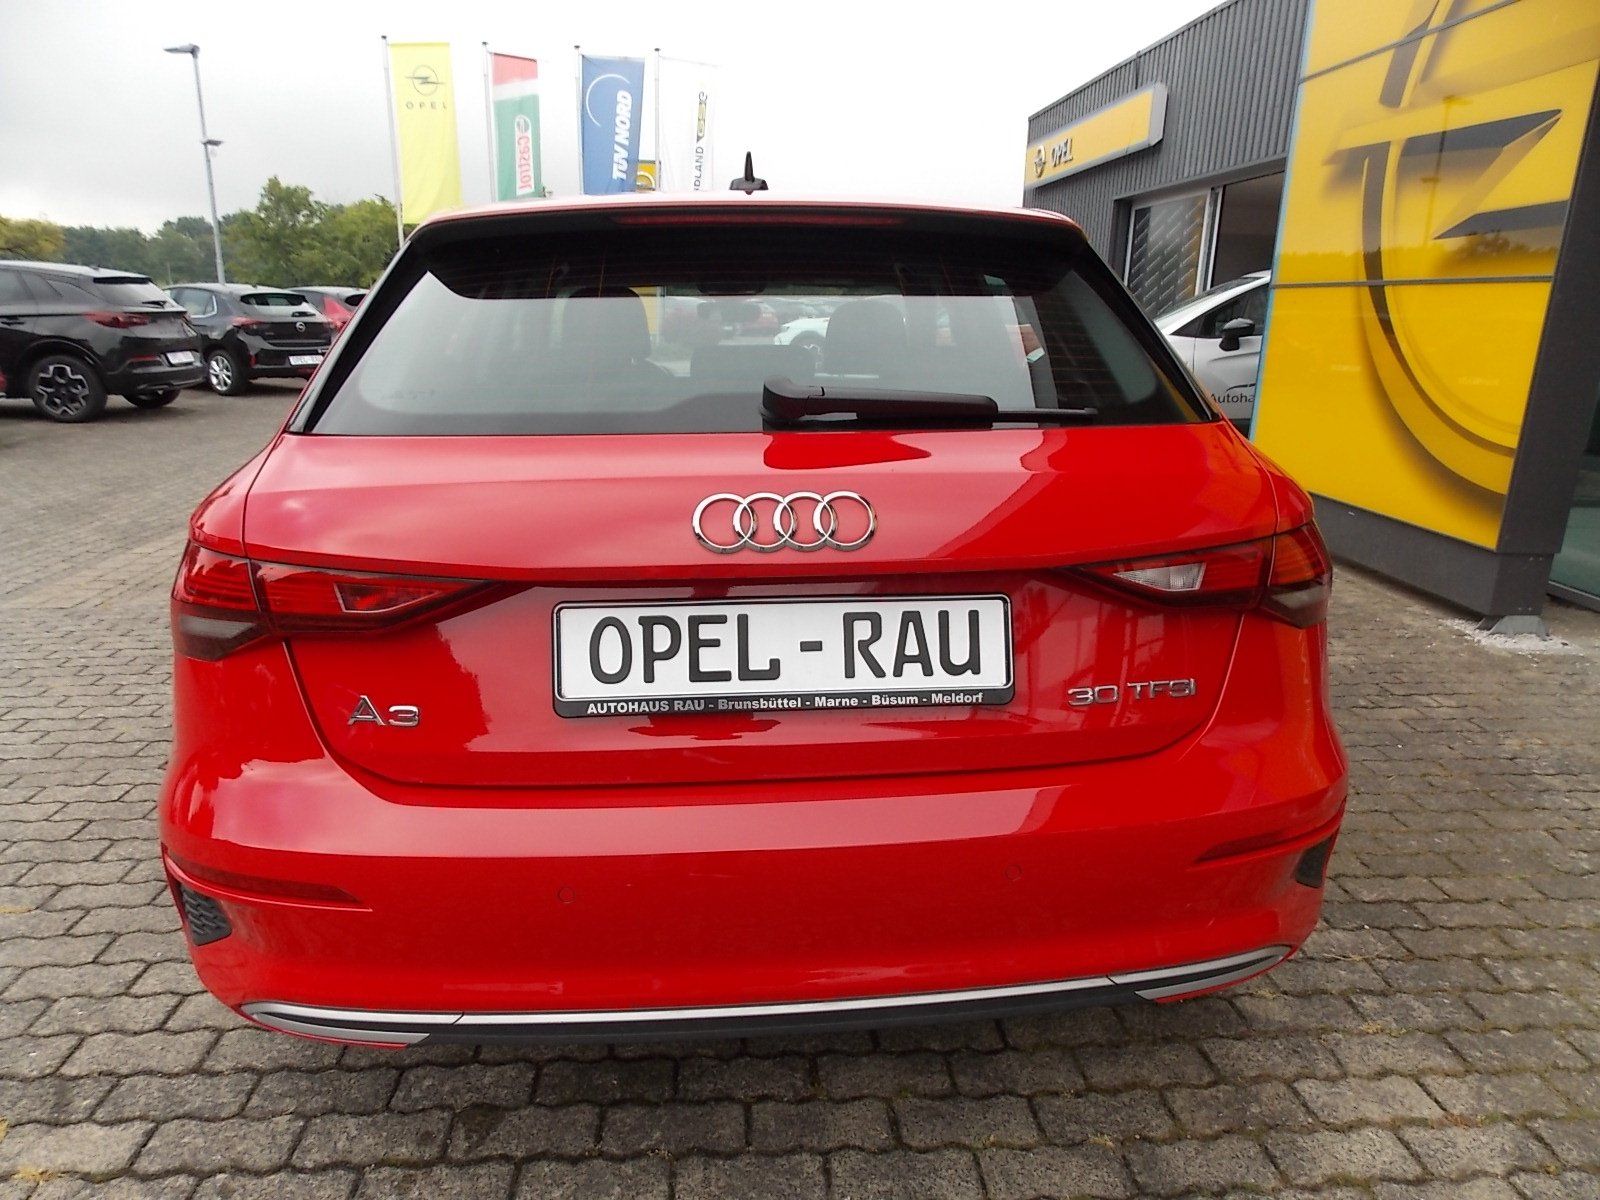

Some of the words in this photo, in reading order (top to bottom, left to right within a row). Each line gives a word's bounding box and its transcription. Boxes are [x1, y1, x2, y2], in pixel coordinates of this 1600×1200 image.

[405, 101, 446, 110] OPEL
[614, 90, 632, 146] NORD
[1051, 138, 1073, 167] OPEL
[589, 614, 781, 684] OPEL
[800, 640, 823, 652] -
[843, 609, 981, 678] RAU
[587, 700, 670, 715] AUTOHAUS
[673, 698, 705, 711] RAU
[718, 697, 801, 711] Brunsbüttel
[814, 695, 859, 708] Marne
[871, 693, 919, 706] Büsum
[931, 692, 984, 704] Meldorf
[1067, 684, 1119, 706] 30
[1126, 678, 1196, 699] TFSI
[347, 694, 419, 727] A3
